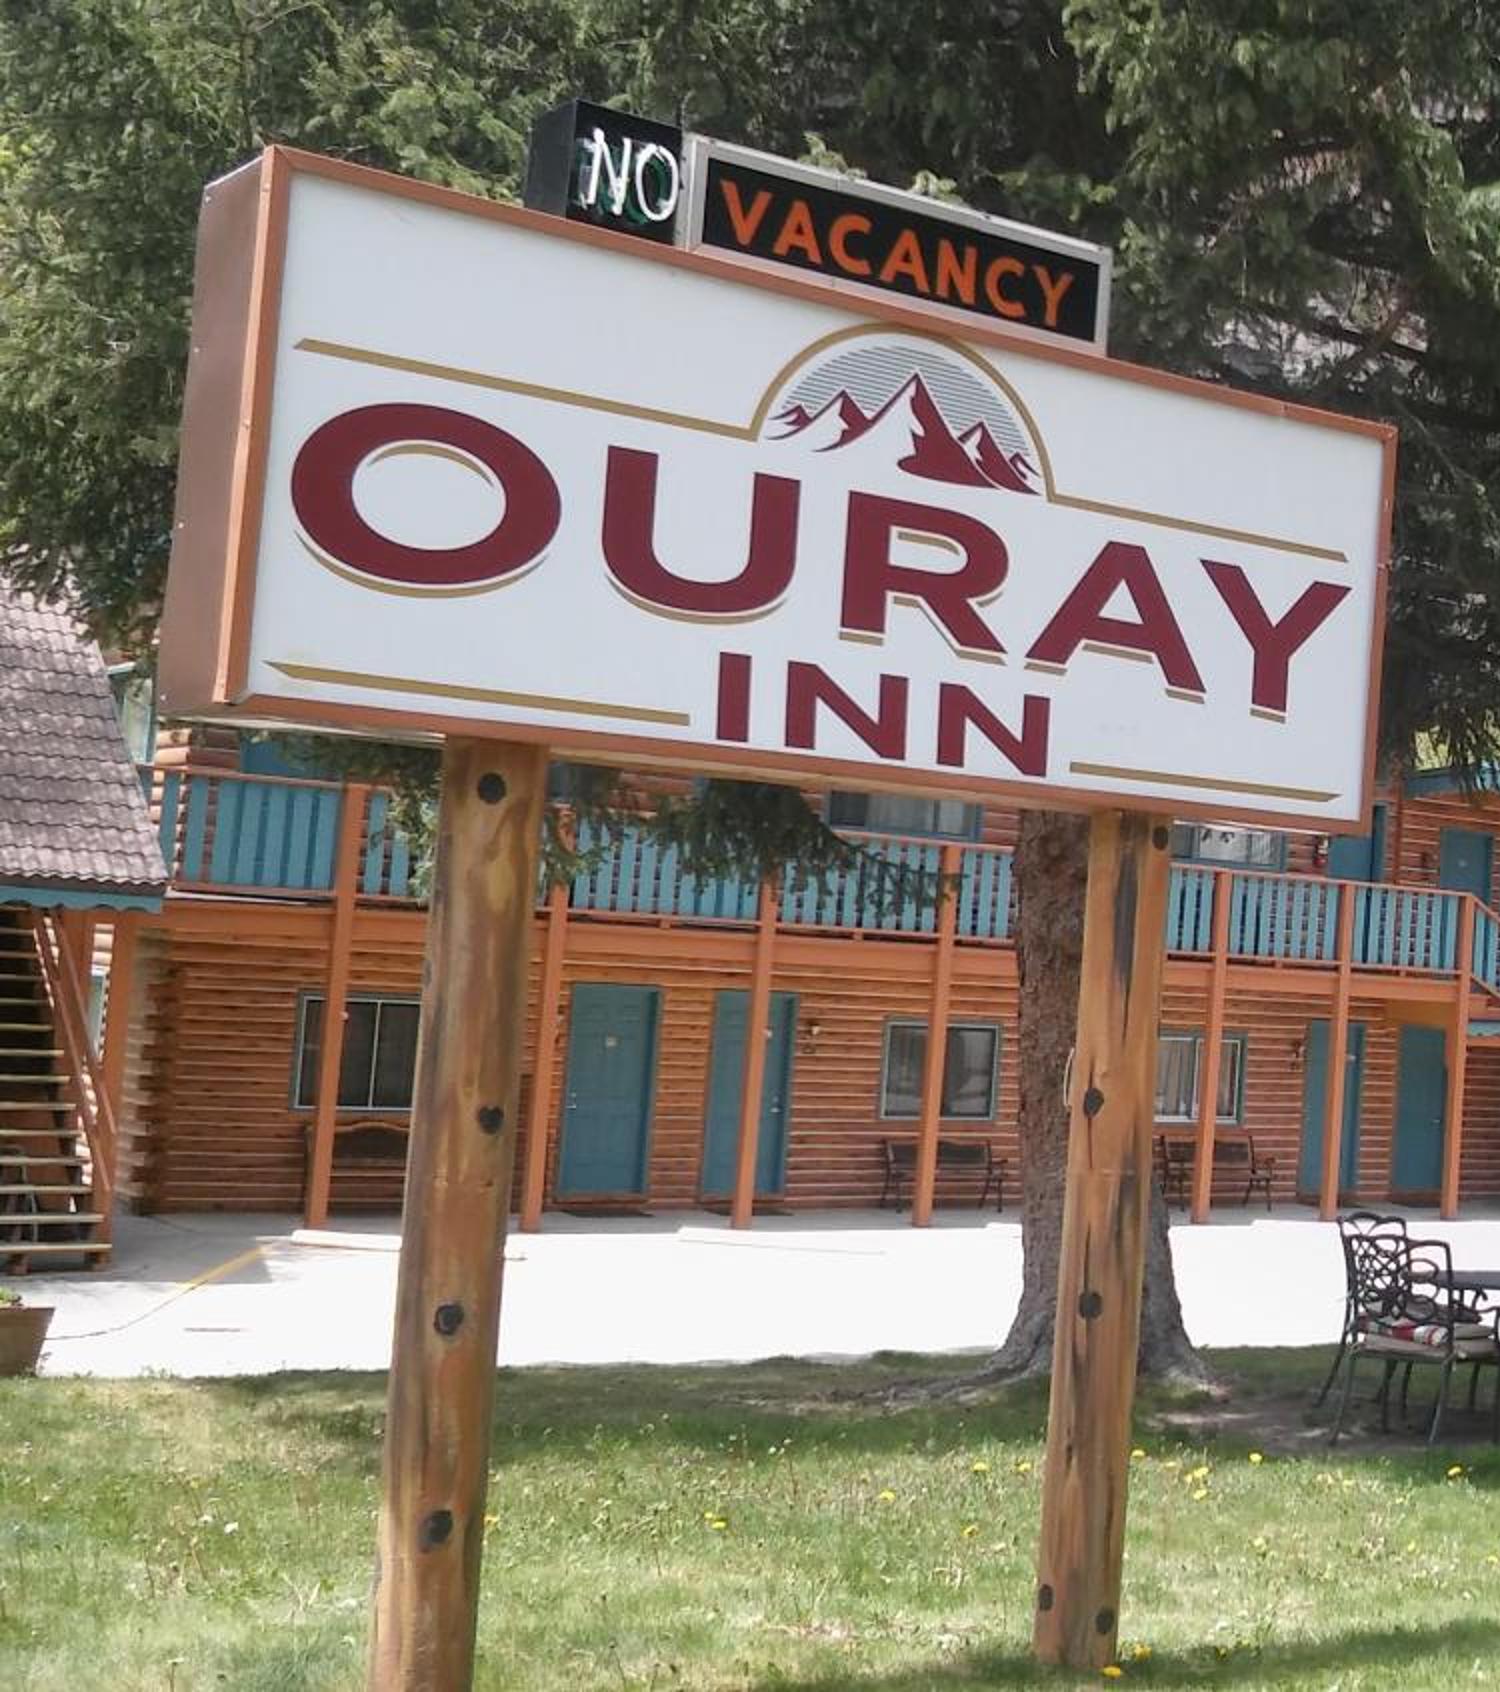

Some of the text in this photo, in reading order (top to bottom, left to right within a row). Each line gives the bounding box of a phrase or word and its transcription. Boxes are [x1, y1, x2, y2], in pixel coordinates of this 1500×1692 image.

[576, 127, 1075, 327] NO VACANCY
[290, 403, 1353, 714] OURAY
[716, 652, 1050, 777] INN
